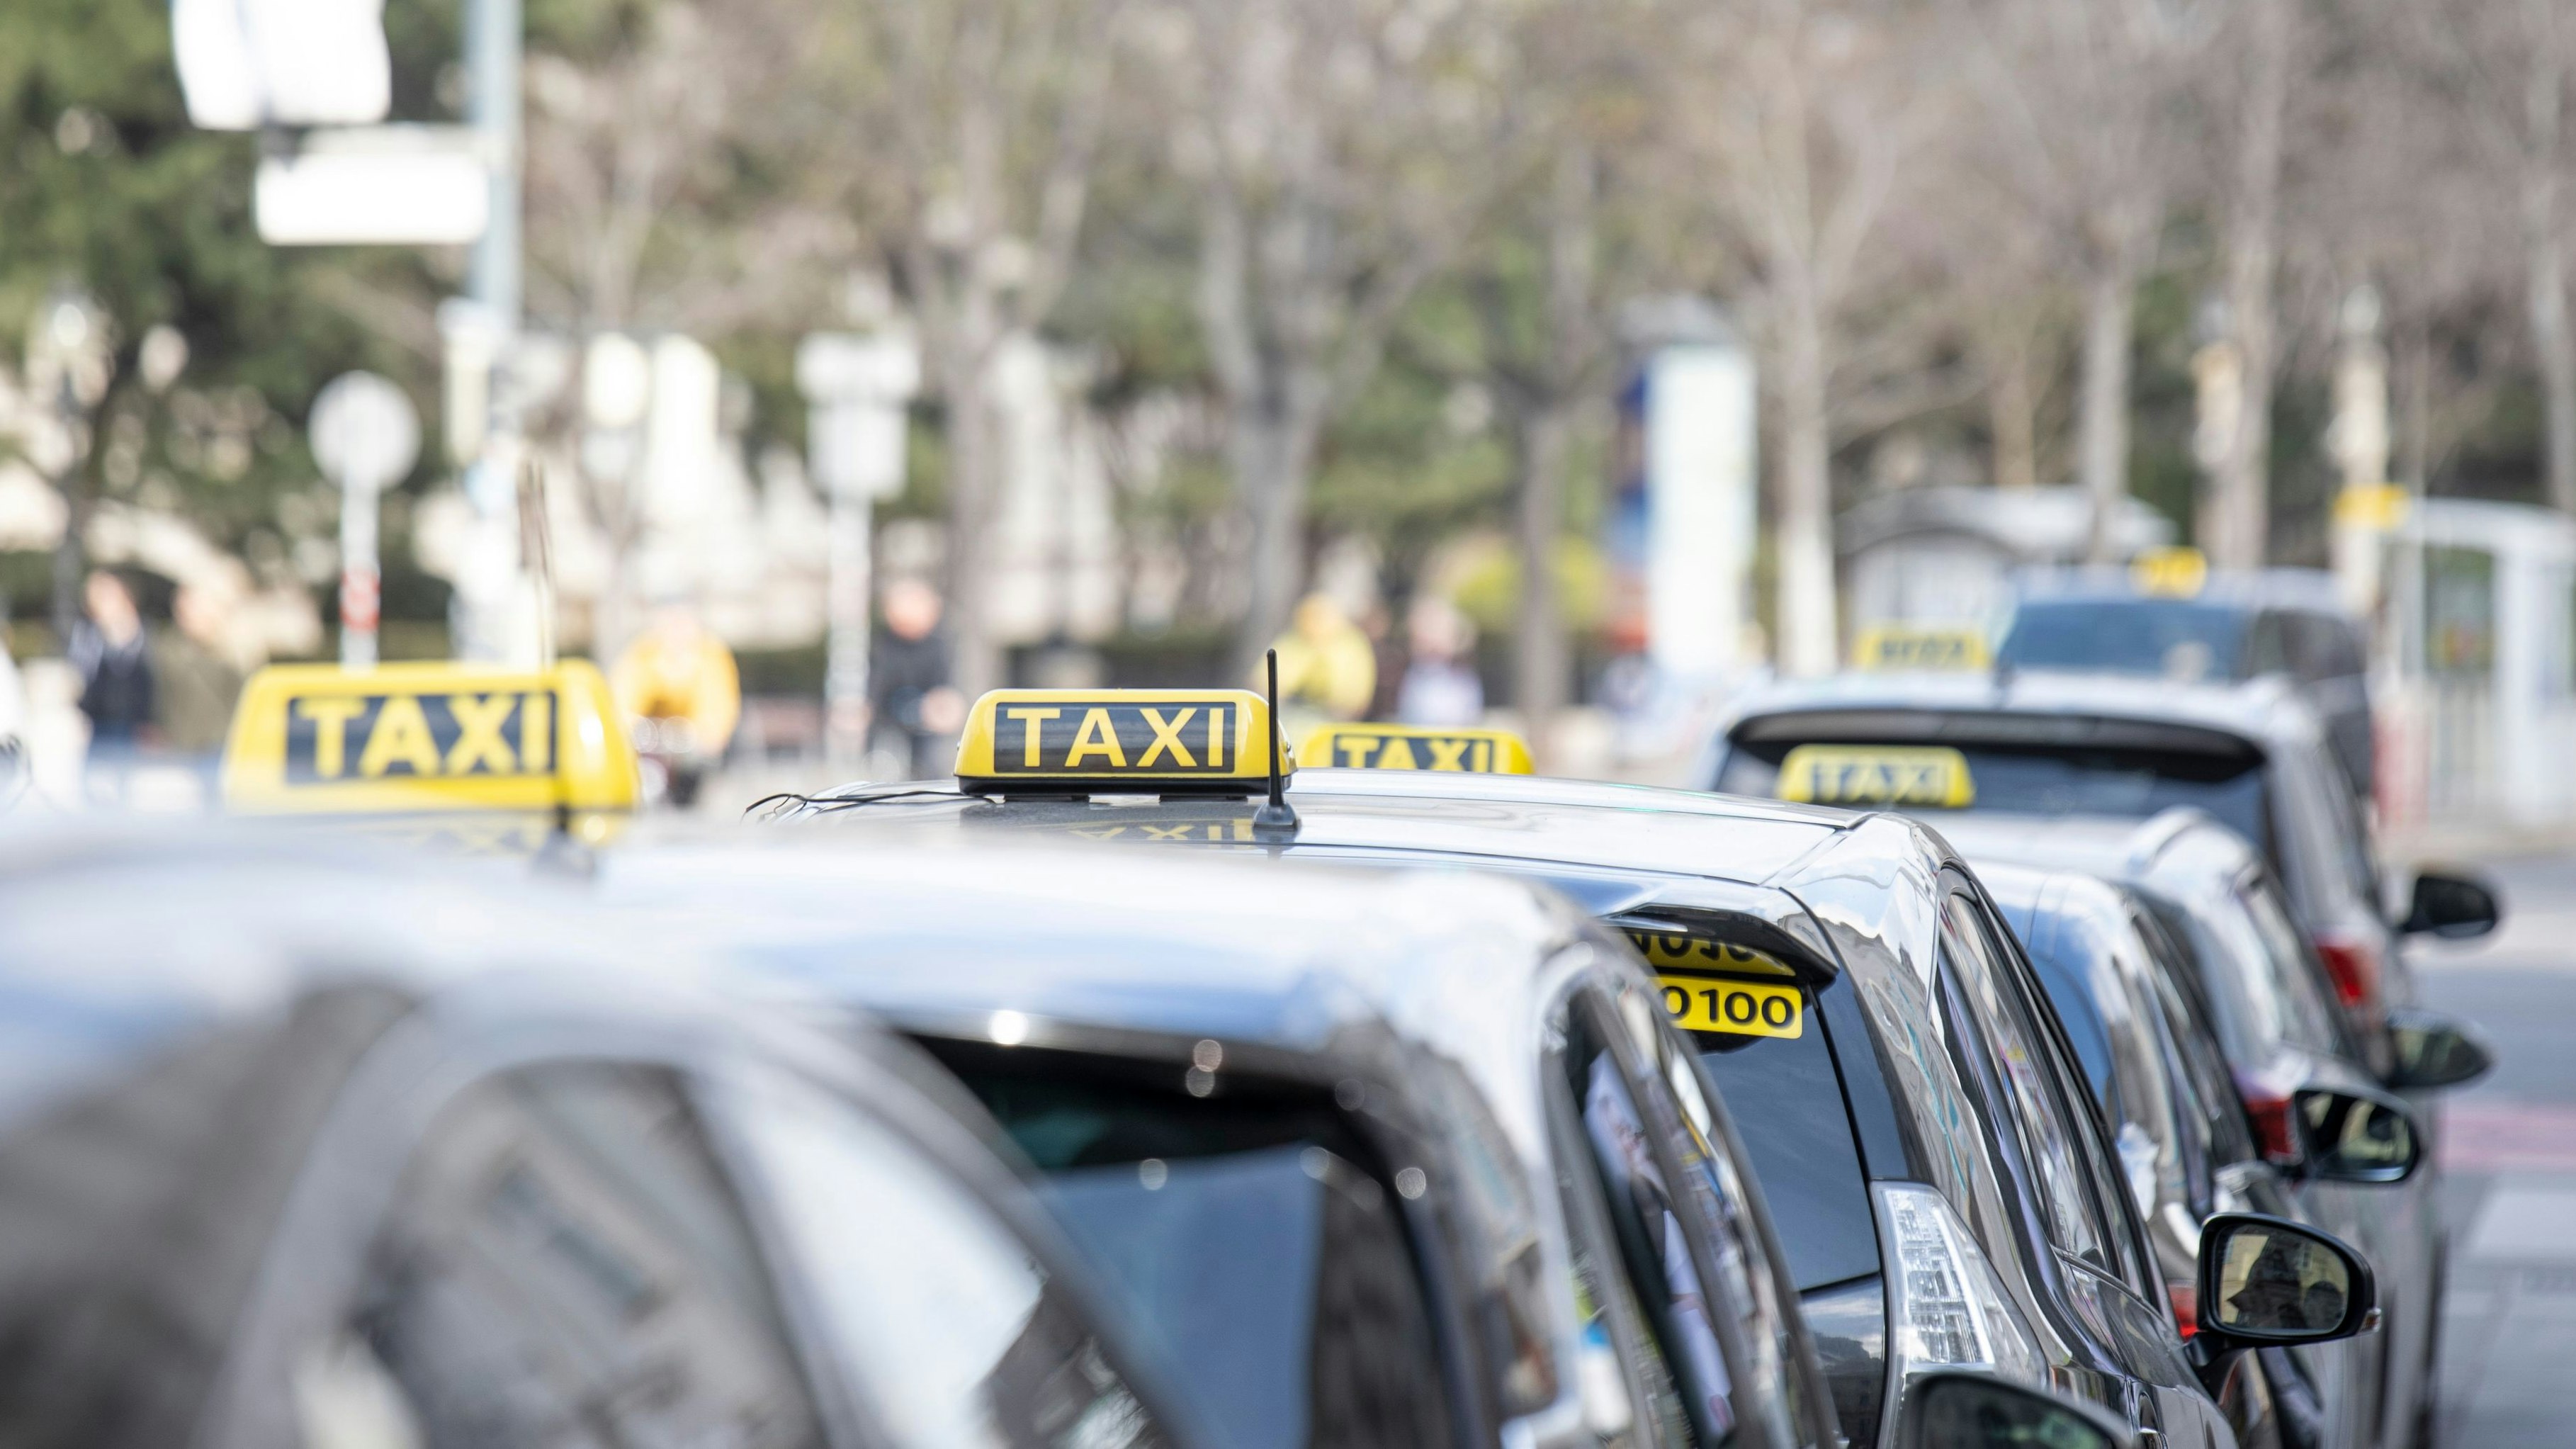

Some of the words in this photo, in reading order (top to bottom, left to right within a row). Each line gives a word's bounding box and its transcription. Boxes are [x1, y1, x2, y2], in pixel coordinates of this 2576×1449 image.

[295, 695, 550, 777] TAXI
[1007, 707, 1224, 767] TAXI
[1336, 735, 1489, 772] TAXI
